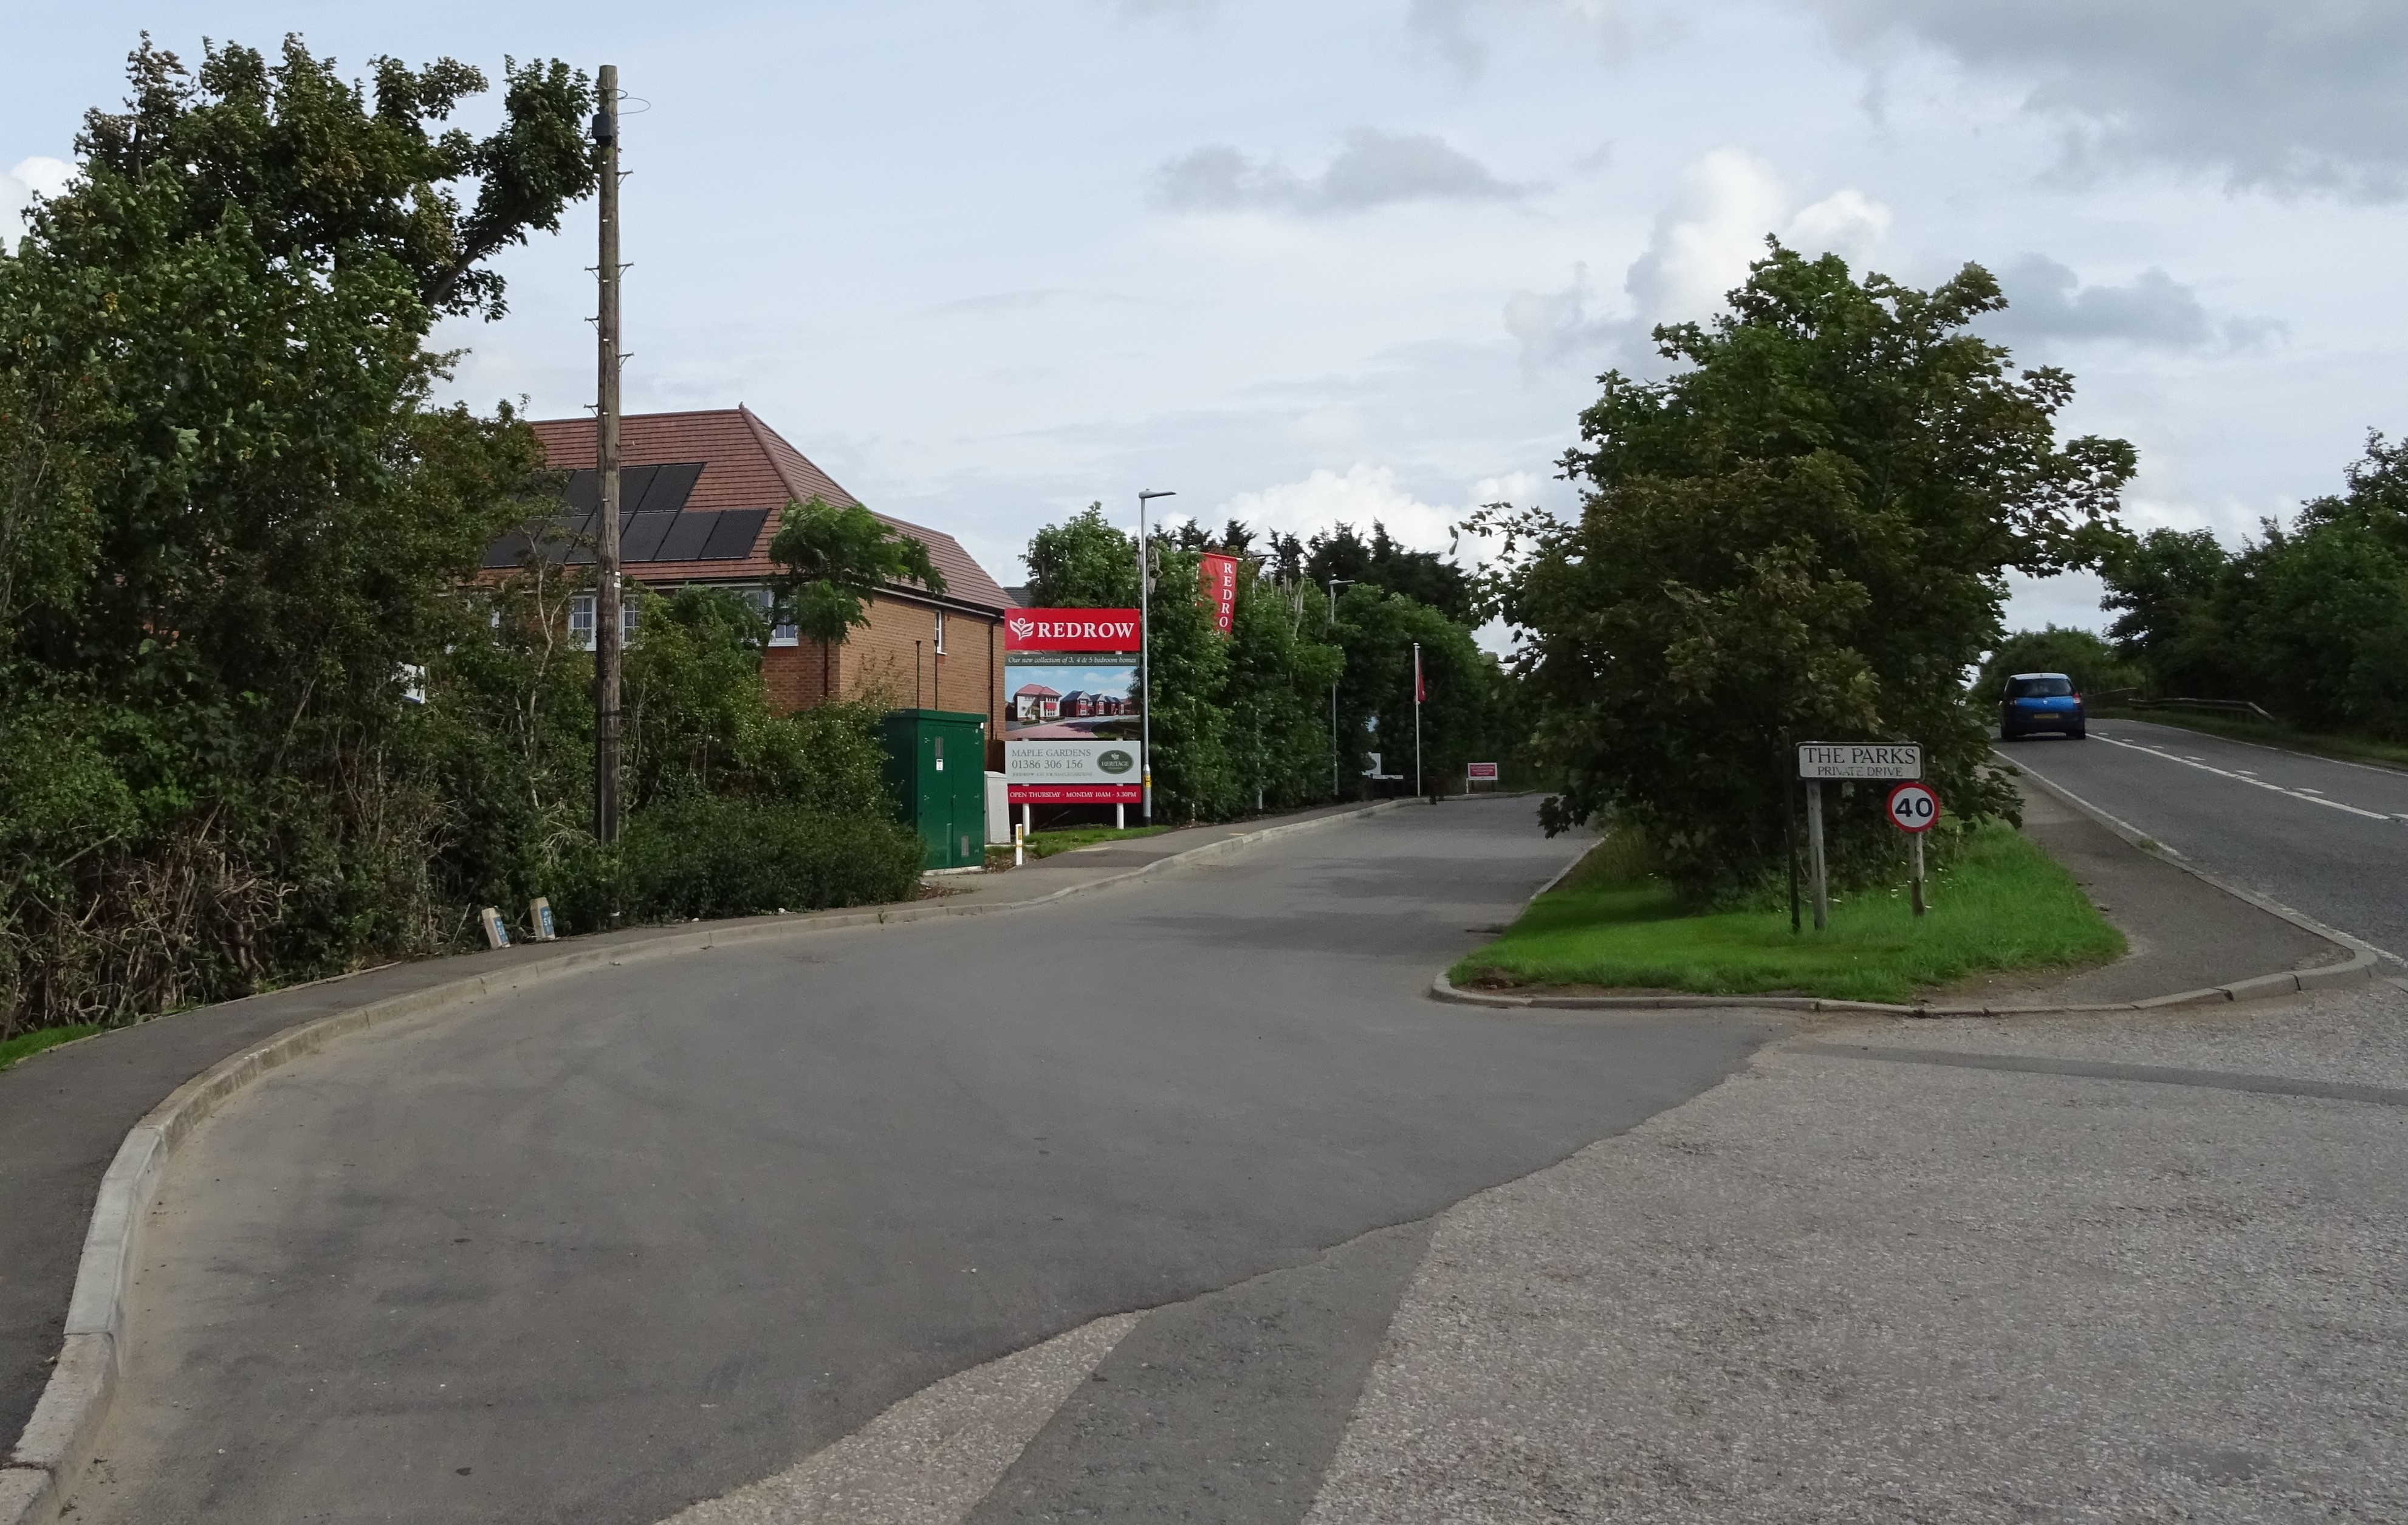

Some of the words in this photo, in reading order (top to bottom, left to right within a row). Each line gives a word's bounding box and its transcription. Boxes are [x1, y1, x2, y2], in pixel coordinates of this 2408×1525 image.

[1219, 562, 1233, 628] REDRO
[1037, 622, 1134, 638] REDROW
[1062, 657, 1068, 665] of
[1012, 749, 1043, 757] MAPLE
[1046, 749, 1091, 757] GARDENS
[1803, 747, 1845, 764] THE
[1851, 748, 1915, 764] PARKS
[1012, 759, 1041, 769] 01386
[1044, 759, 1062, 769] 306
[1066, 759, 1083, 769] 156
[1817, 766, 1864, 776] PRIVATE
[1867, 767, 1903, 777] DRIVE
[1895, 797, 1933, 818] 40
